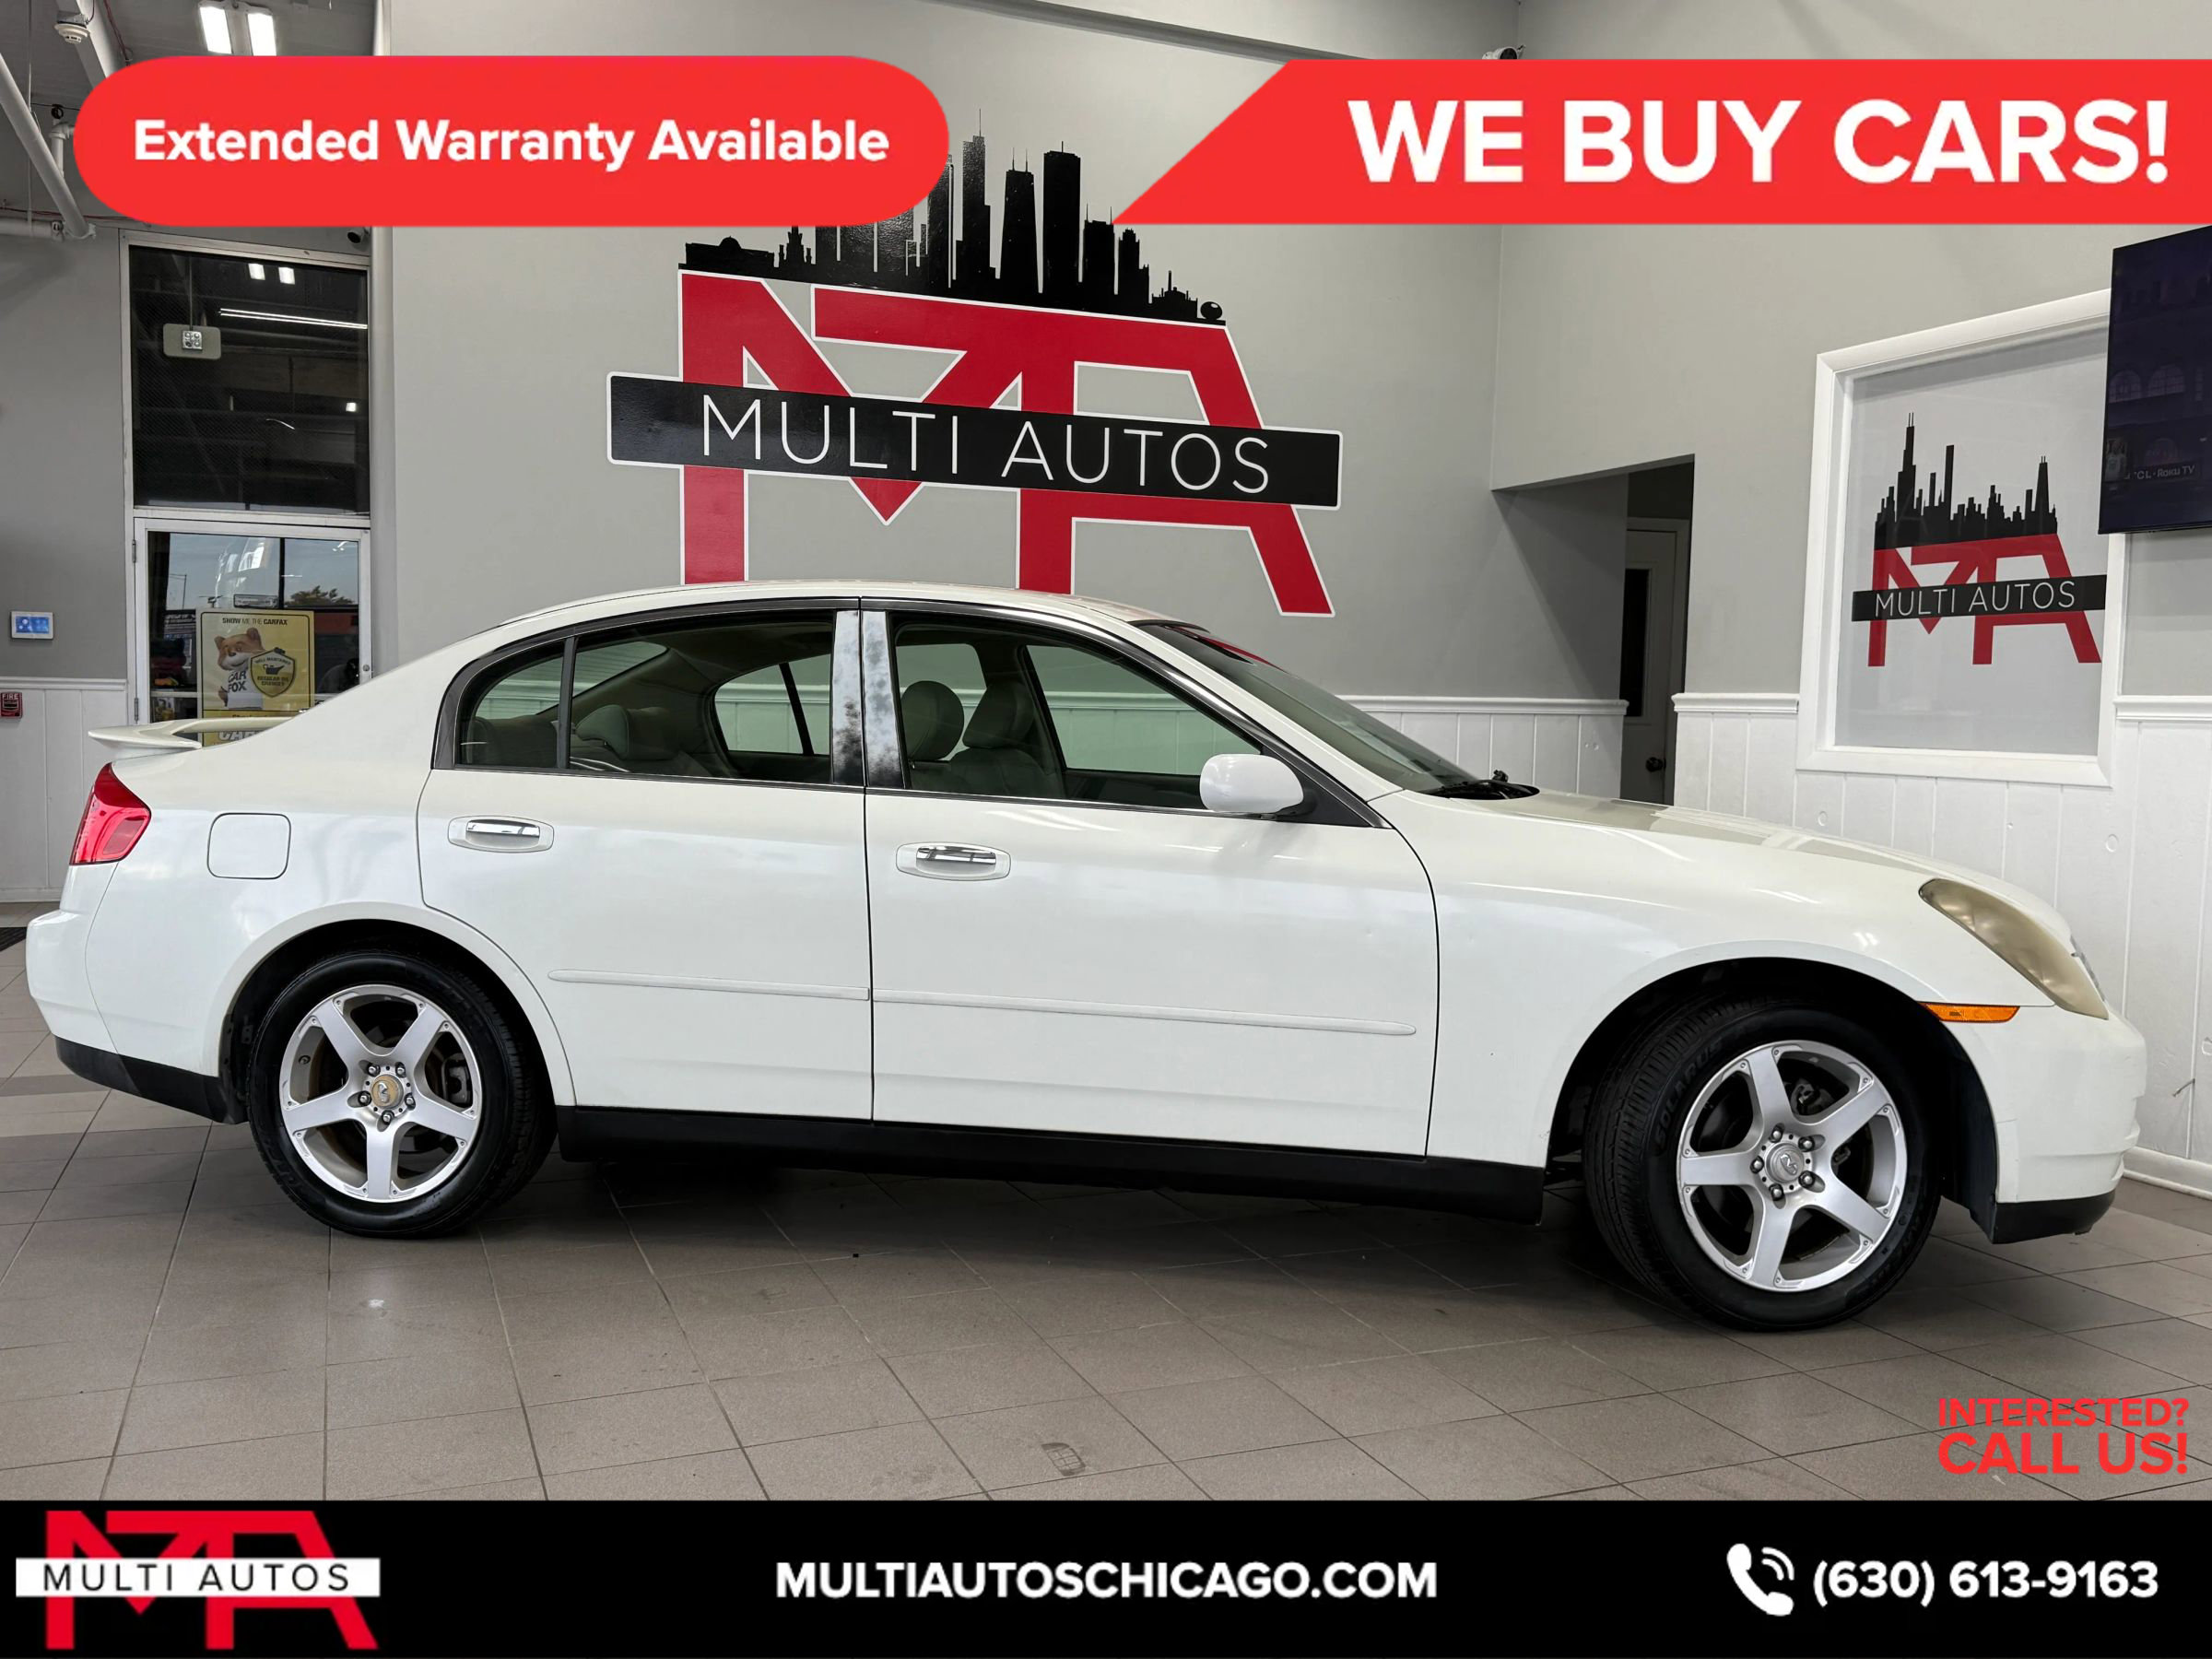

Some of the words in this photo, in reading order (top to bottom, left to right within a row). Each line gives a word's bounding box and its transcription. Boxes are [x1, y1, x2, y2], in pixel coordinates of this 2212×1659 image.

[703, 394, 959, 475] MULTI
[1002, 420, 1268, 495] AUTOS
[2182, 465, 2195, 475] TV
[1875, 589, 1956, 618] MULTI
[1969, 581, 2076, 612] AUTOS
[228, 670, 247, 683] CAR
[228, 681, 247, 693] FOX
[1653, 1035, 1726, 1150] SOLARUS
